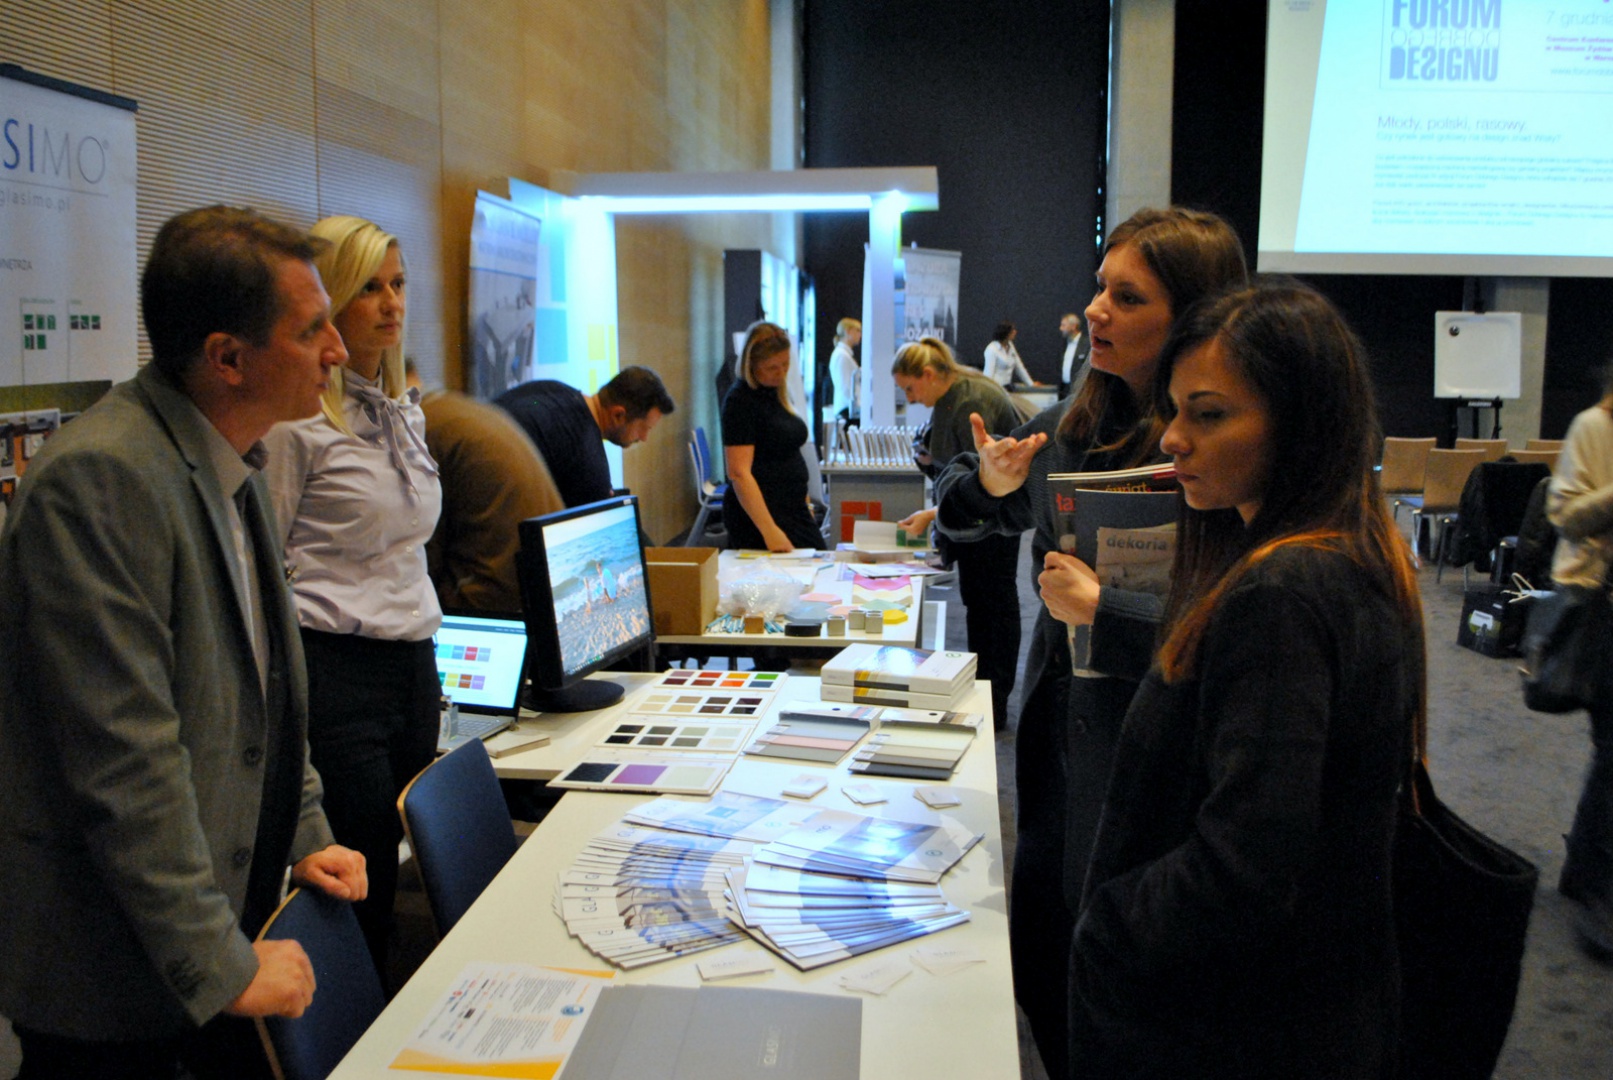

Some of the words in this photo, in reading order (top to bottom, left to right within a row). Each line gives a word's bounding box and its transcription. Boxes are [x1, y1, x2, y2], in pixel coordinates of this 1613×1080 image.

[1392, 0, 1501, 28] FORUM
[1389, 46, 1499, 81] DESIGNU
[1056, 492, 1076, 512] ta
[1106, 535, 1168, 550] dekoria
